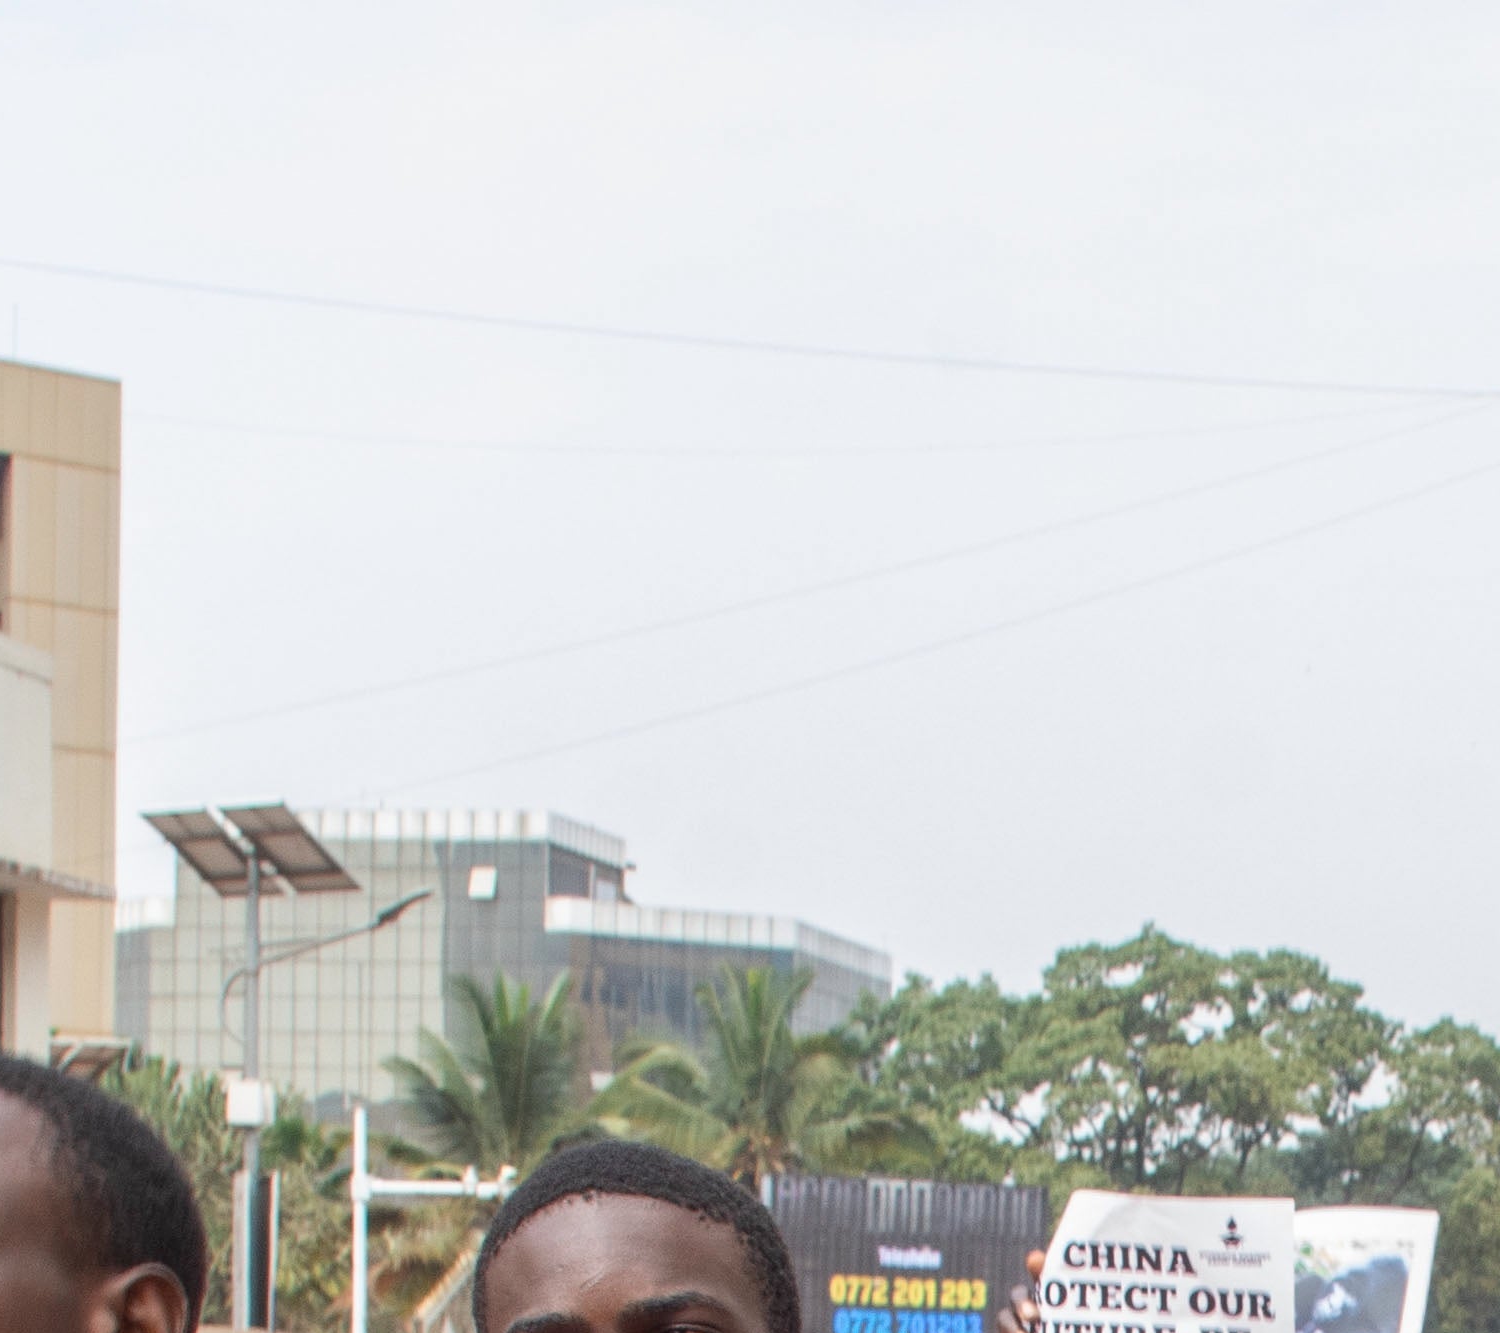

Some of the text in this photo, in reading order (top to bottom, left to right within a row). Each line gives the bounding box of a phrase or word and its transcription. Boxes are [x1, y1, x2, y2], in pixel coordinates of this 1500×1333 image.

[1063, 1240, 1198, 1276] CHINA
[829, 1273, 986, 1309] 0772 201 293
[1189, 1286, 1276, 1321] OUR
